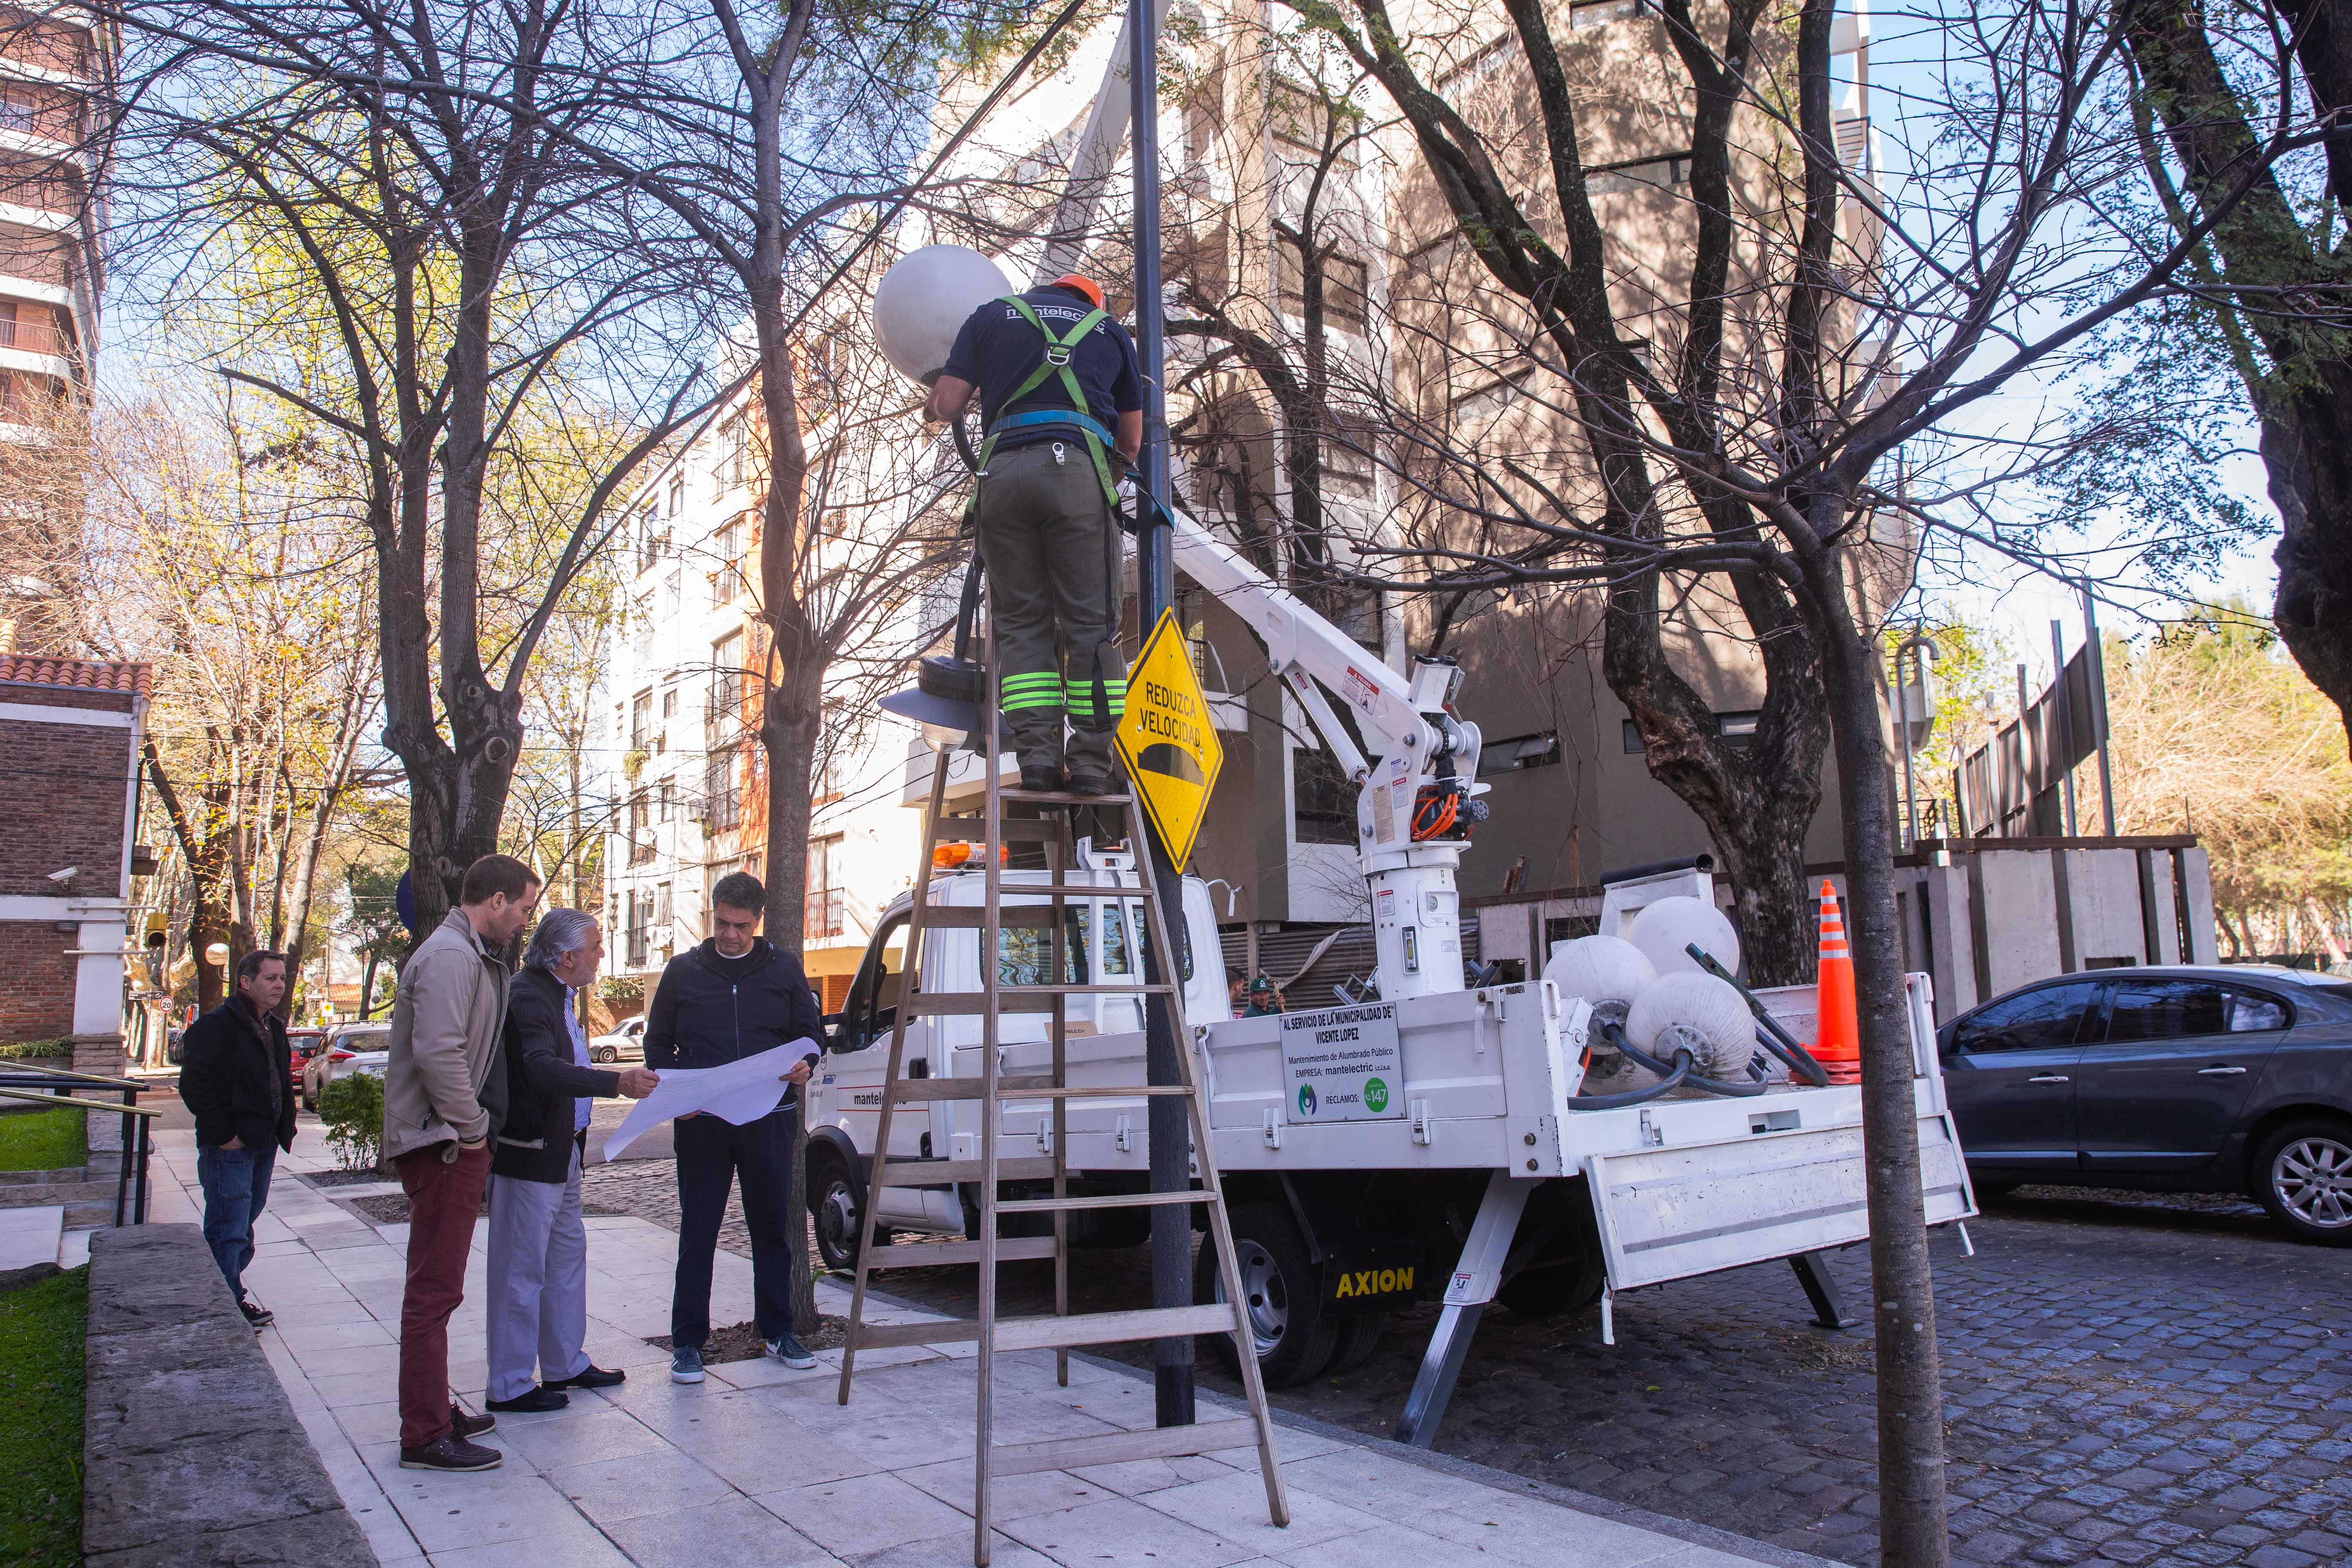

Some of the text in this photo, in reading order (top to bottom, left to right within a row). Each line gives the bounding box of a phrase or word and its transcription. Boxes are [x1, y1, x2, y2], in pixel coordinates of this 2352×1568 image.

[1146, 681, 1197, 720] REDUZCA
[1140, 708, 1200, 748] VELOCIDAD
[1284, 1005, 1391, 1031] AL SERVICIO DE LA MUNICIPALIDAD DE
[1315, 1027, 1359, 1044] VICENTE LOPEZ
[1289, 1054, 1329, 1064] Mantenimiento
[1338, 1049, 1370, 1060] Alumbrado
[1372, 1047, 1393, 1057] Público
[1296, 1068, 1323, 1078] EMPRESA:
[1326, 1063, 1373, 1075] mantelectric
[1326, 1089, 1386, 1104] RECLAMOS: 147
[1336, 1267, 1414, 1298] AXION
